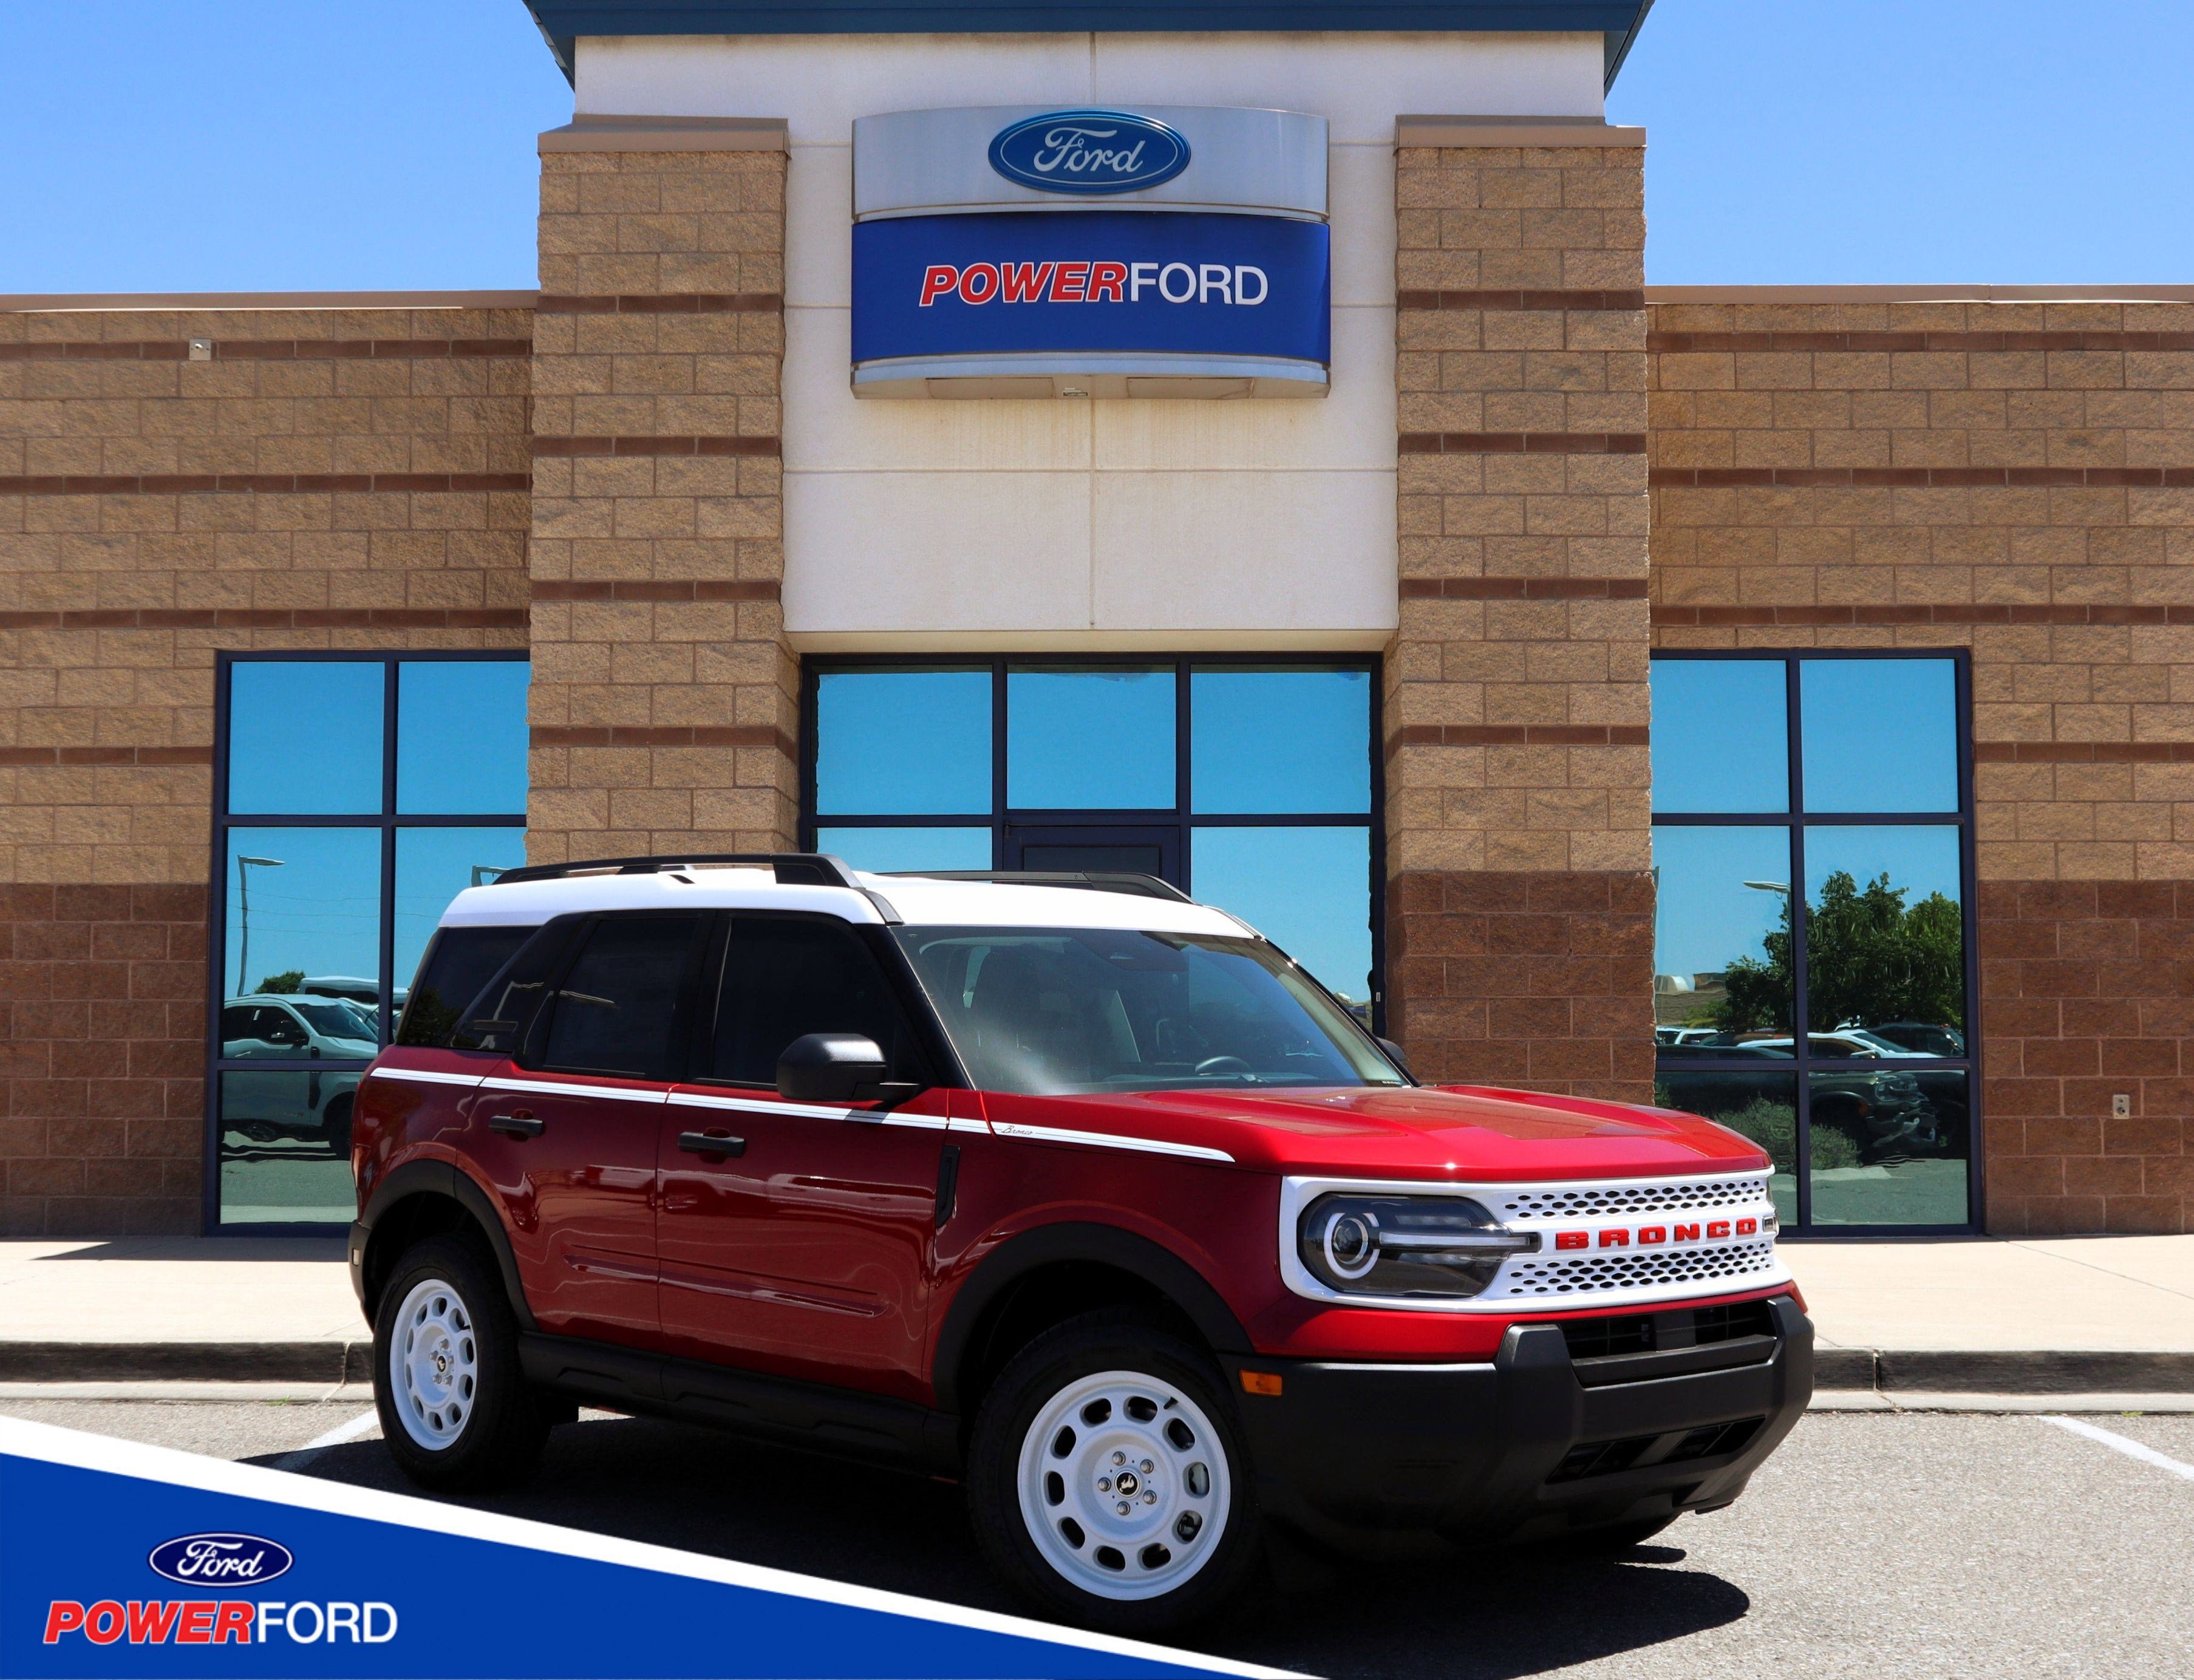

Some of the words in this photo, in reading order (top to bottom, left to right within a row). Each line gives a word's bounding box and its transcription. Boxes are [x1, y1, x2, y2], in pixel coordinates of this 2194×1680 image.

[1034, 127, 1145, 173] Ford
[919, 261, 1269, 307] POWERFORD
[1001, 1126, 1033, 1135] Bronco
[1555, 1217, 1757, 1250] BRONCO
